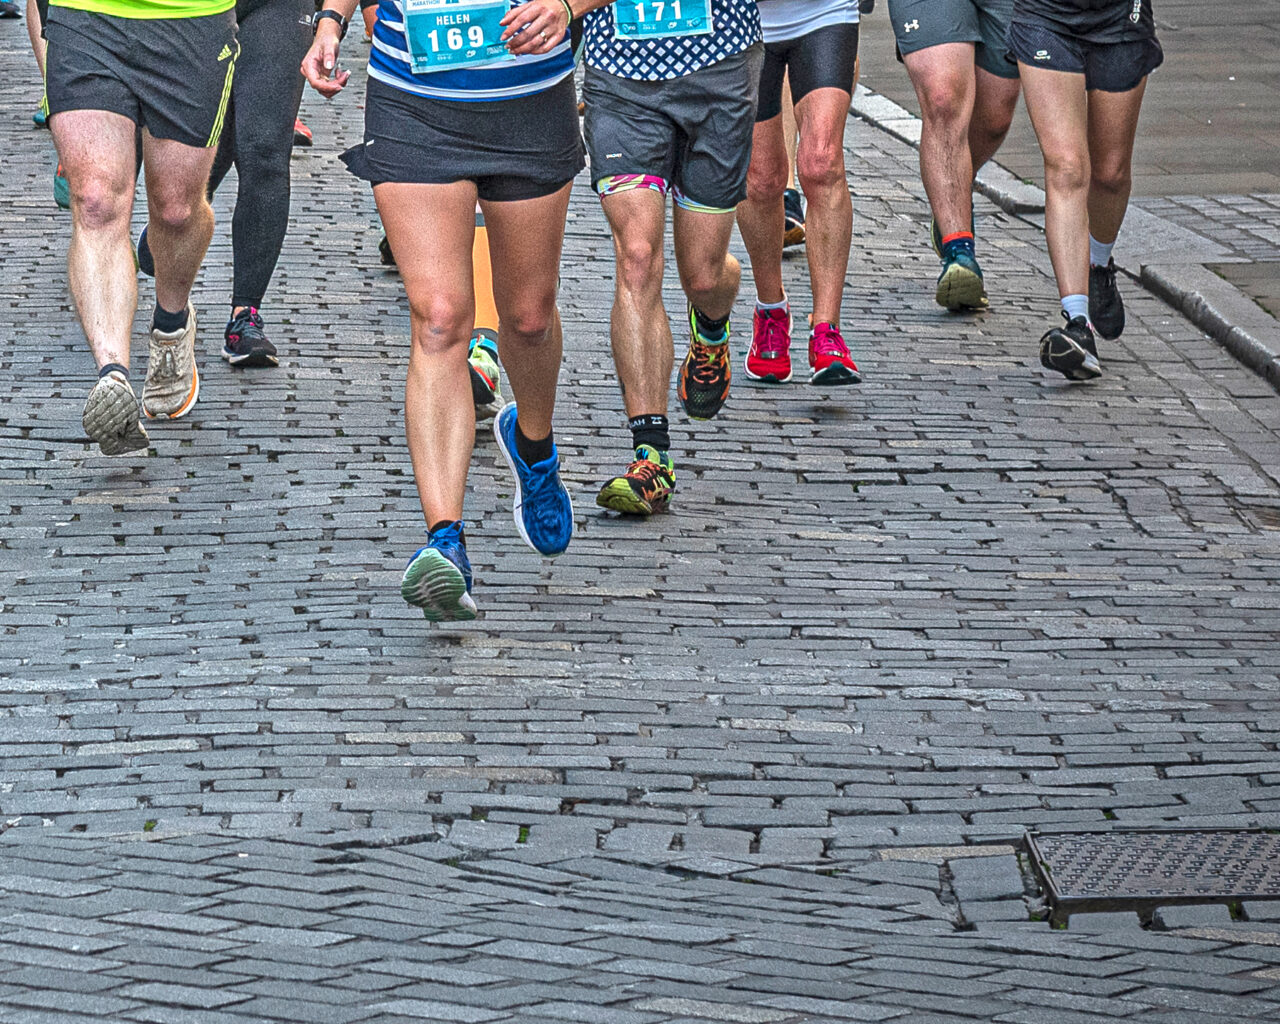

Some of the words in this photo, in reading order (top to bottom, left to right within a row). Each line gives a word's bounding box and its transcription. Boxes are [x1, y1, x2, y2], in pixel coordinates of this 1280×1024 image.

[436, 13, 470, 25] HELEN
[634, 0, 682, 23] 171
[428, 25, 484, 52] 169
